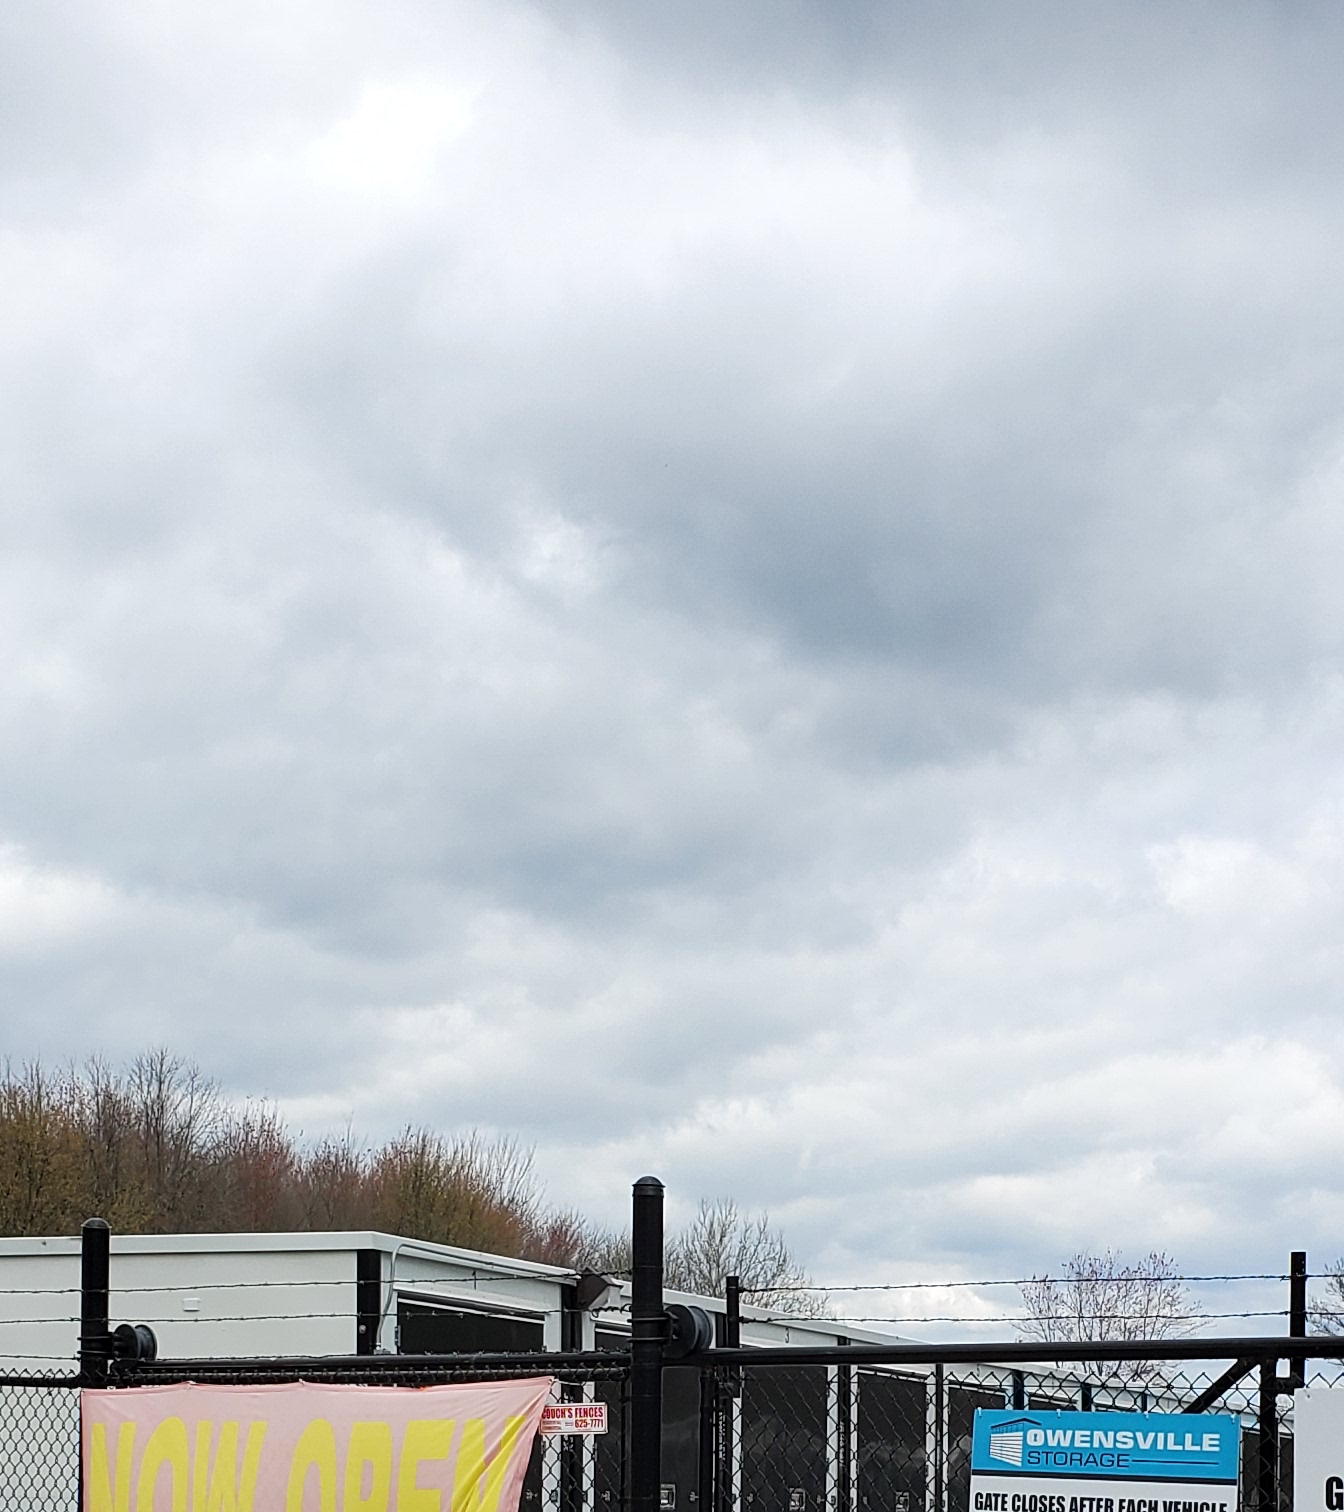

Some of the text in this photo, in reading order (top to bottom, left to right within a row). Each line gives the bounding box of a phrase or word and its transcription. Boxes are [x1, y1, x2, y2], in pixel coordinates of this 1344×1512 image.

[575, 1407, 603, 1418] FENCES
[575, 1419, 603, 1428] 625-7771
[1027, 1429, 1220, 1452] OWENSVILLE
[1027, 1452, 1130, 1468] STORAGE
[975, 1492, 1008, 1512] GATE
